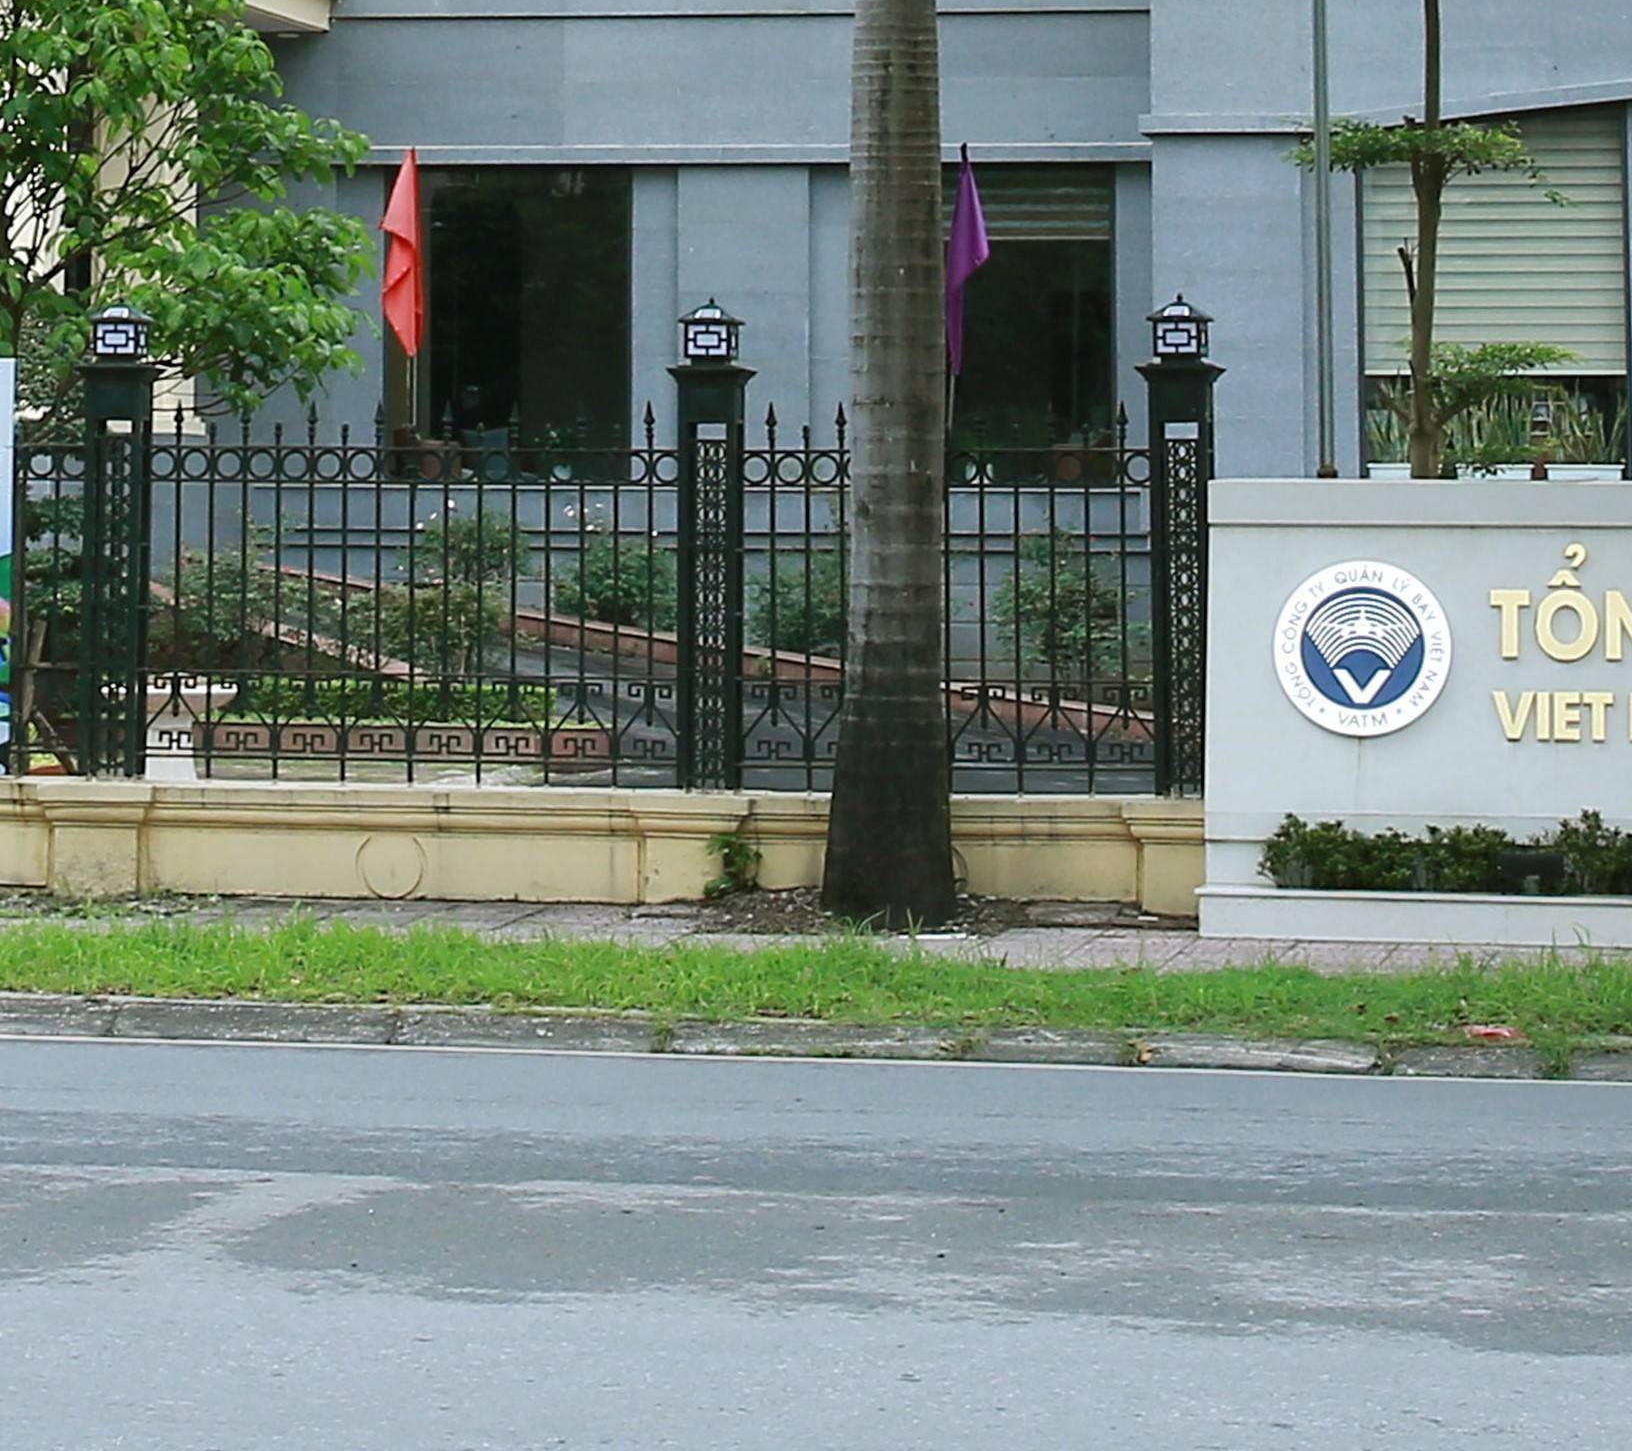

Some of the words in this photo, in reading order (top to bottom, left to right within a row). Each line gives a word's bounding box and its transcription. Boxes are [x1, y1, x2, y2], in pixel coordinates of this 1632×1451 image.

[1334, 565, 1383, 584] QUẢN
[1392, 576, 1410, 593] LÝ
[1309, 581, 1325, 598] TY
[1411, 593, 1436, 621] BAY
[1281, 600, 1308, 654] CÔNG
[1408, 669, 1438, 707] NAM
[1338, 712, 1388, 728] VATM
[1493, 690, 1612, 742] VIET
